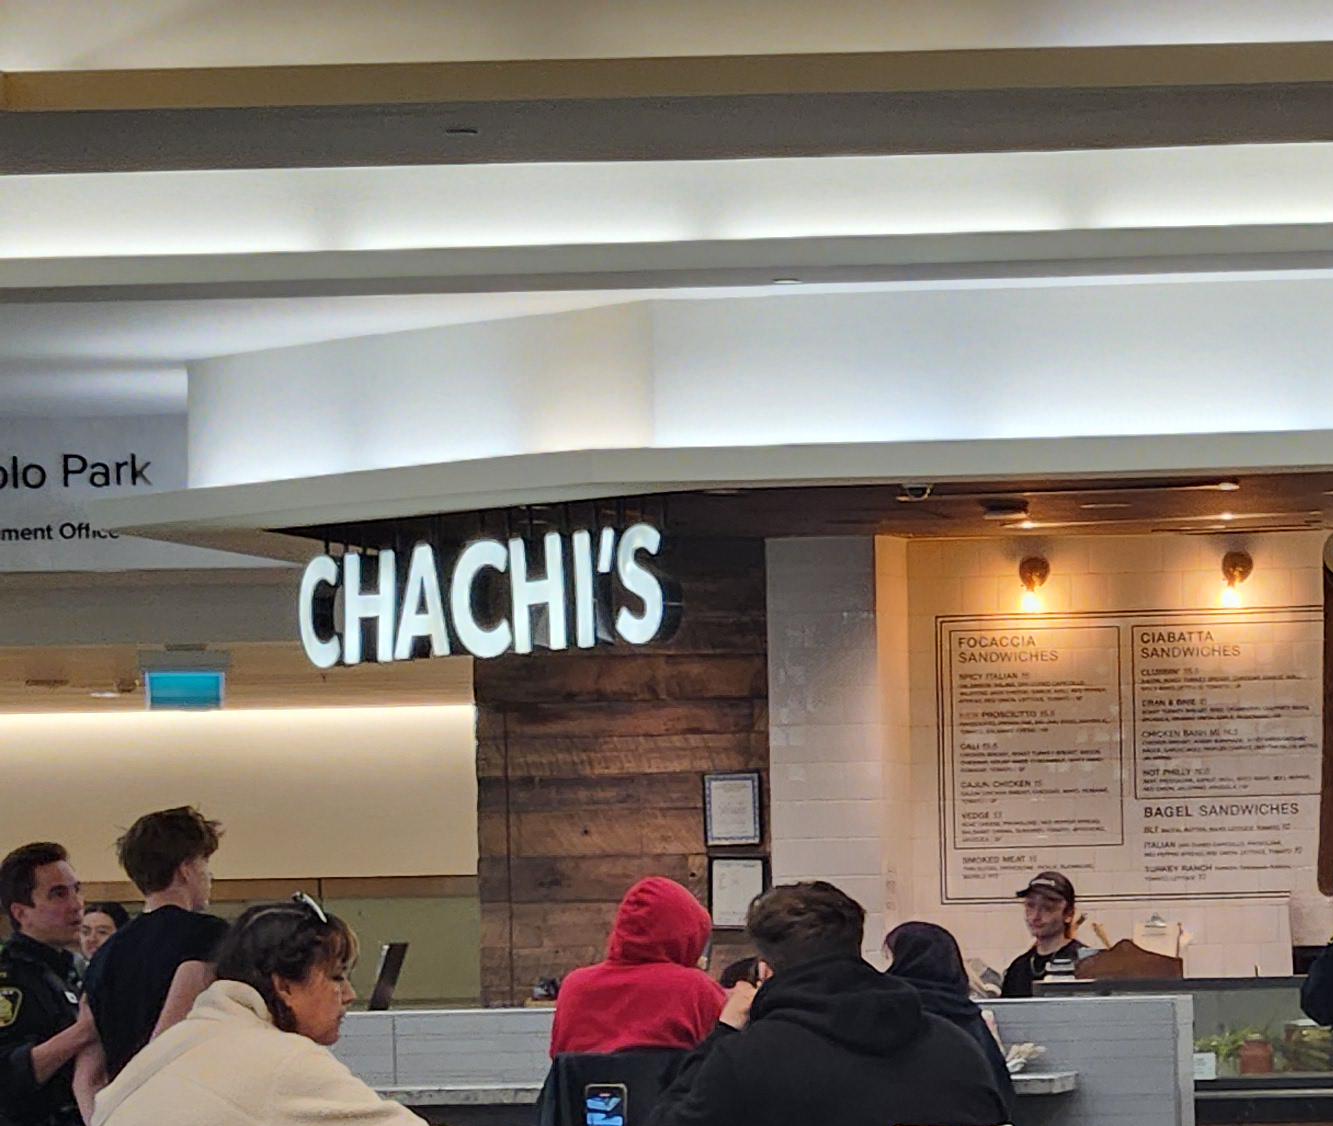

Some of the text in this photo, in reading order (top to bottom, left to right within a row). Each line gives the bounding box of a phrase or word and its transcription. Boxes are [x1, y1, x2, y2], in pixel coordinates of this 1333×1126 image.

[63, 453, 152, 487] Park
[299, 522, 664, 668] CHACHI'S
[958, 636, 1036, 648] FOCACCIA
[1141, 631, 1214, 644] CIABATTA
[958, 650, 1059, 664] SANDWICHES
[1141, 645, 1241, 659] SANDWICHES
[1144, 803, 1300, 818] BAGEL SANDWICHES
